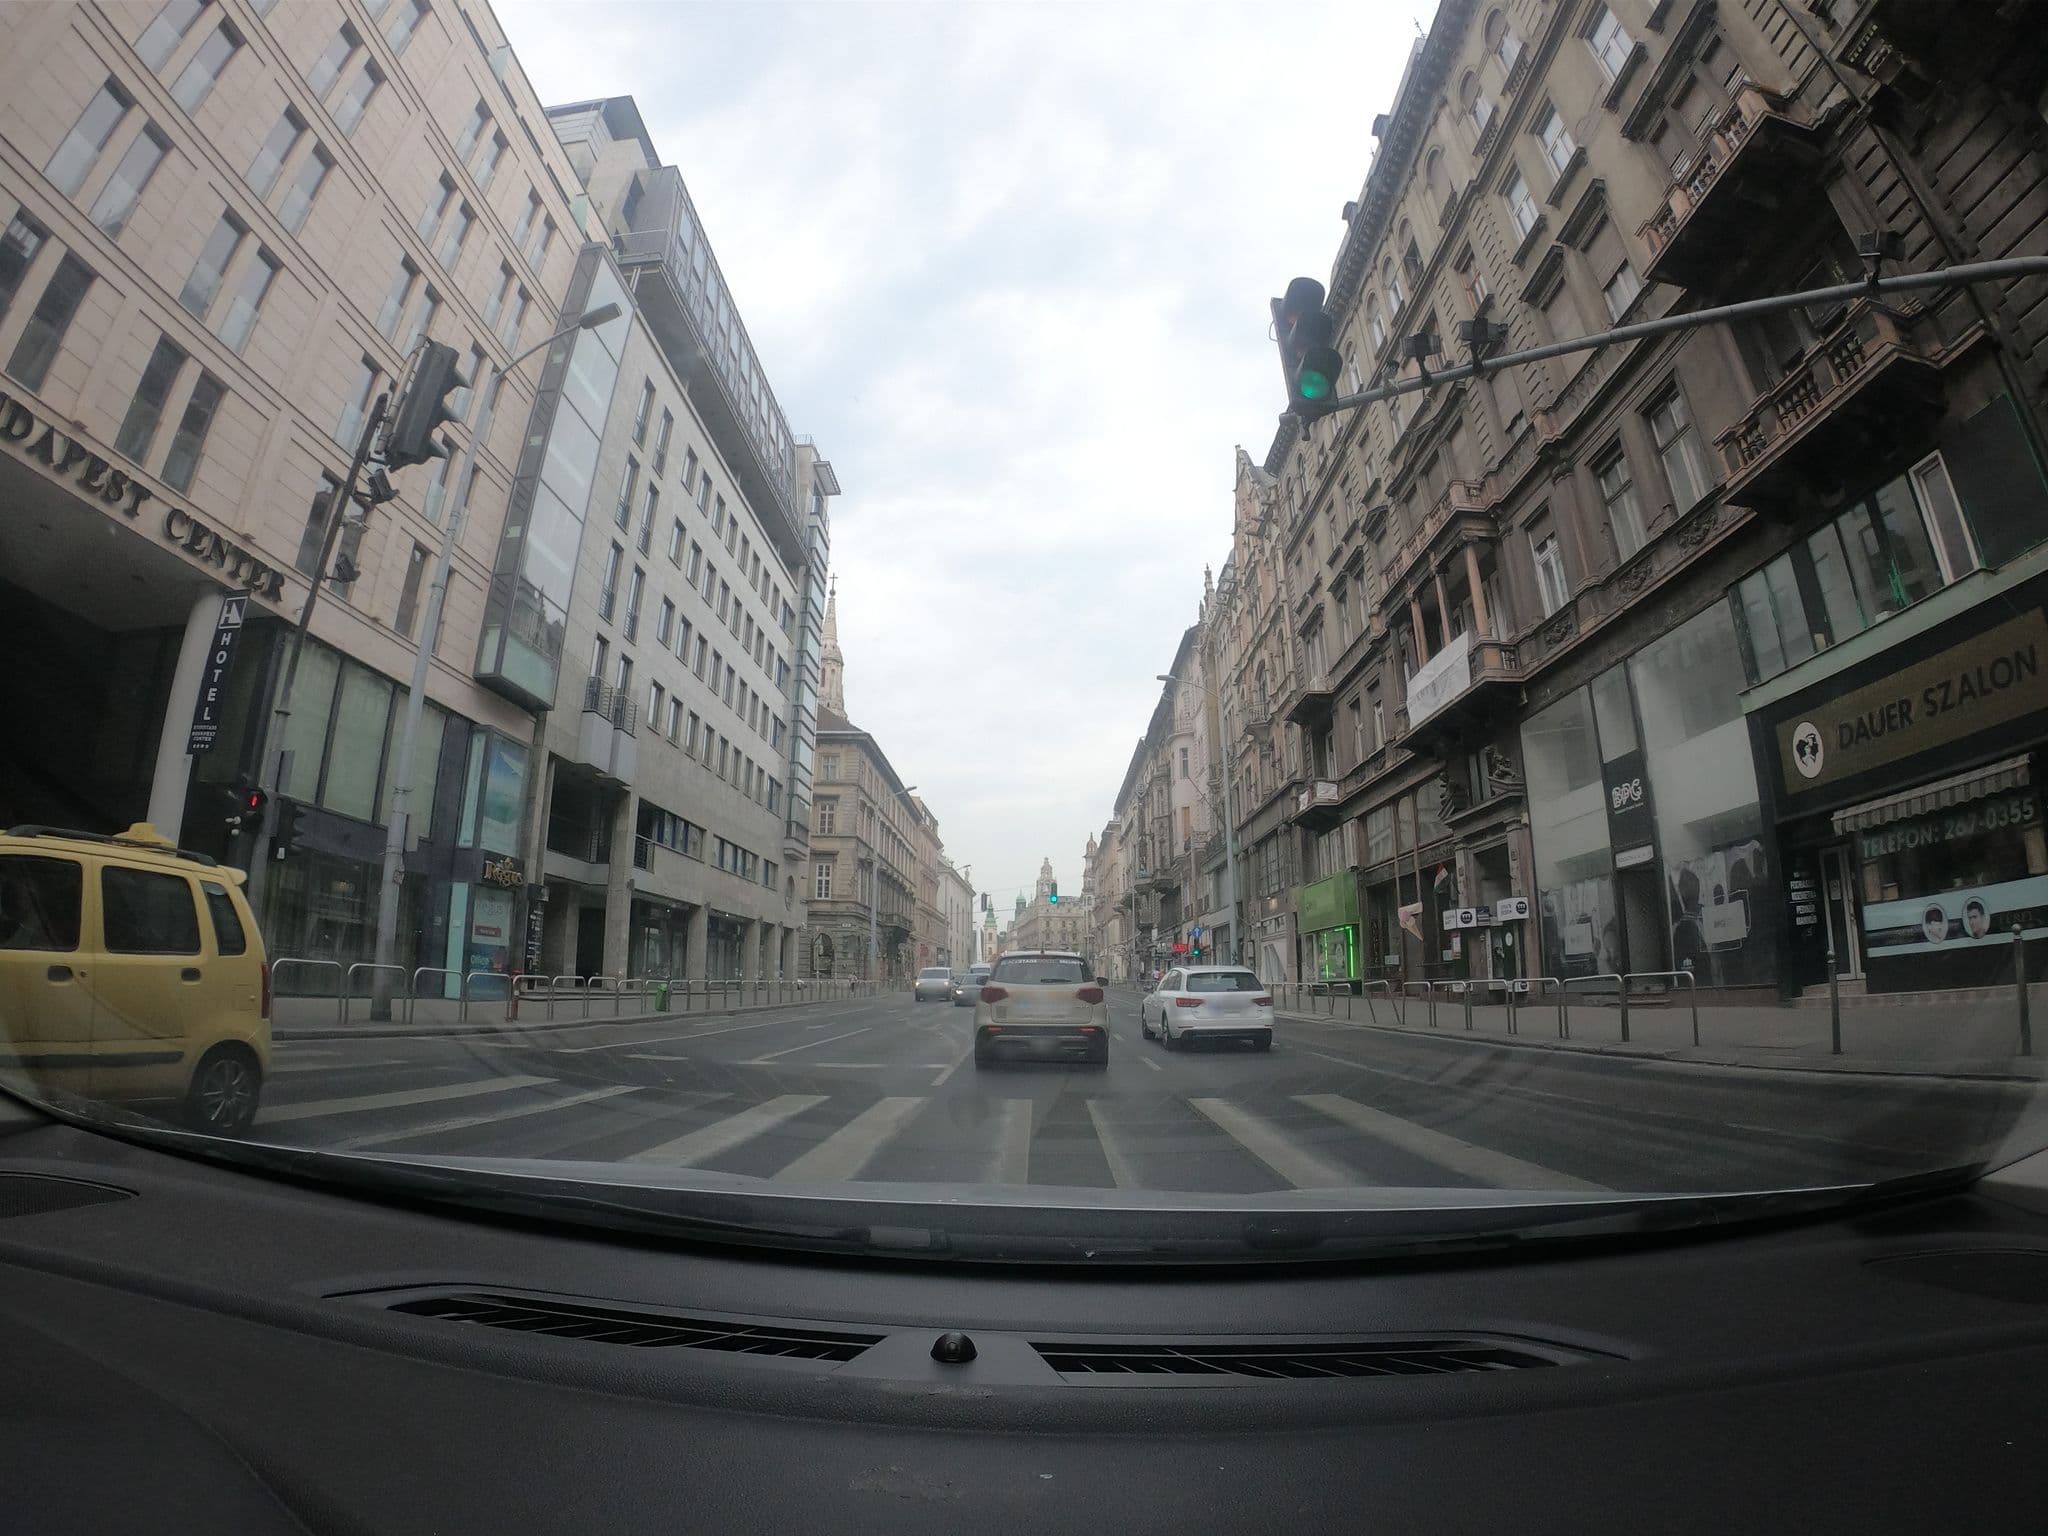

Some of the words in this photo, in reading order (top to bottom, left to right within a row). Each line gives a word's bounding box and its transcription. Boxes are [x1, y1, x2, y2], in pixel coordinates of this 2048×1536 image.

[0, 391, 152, 519] DAPEST
[163, 508, 286, 602] CENTER
[203, 632, 232, 721] HOTEL
[1838, 698, 1914, 750] DAUER
[1925, 645, 2038, 717] SZALON
[1612, 778, 1643, 809] BPG
